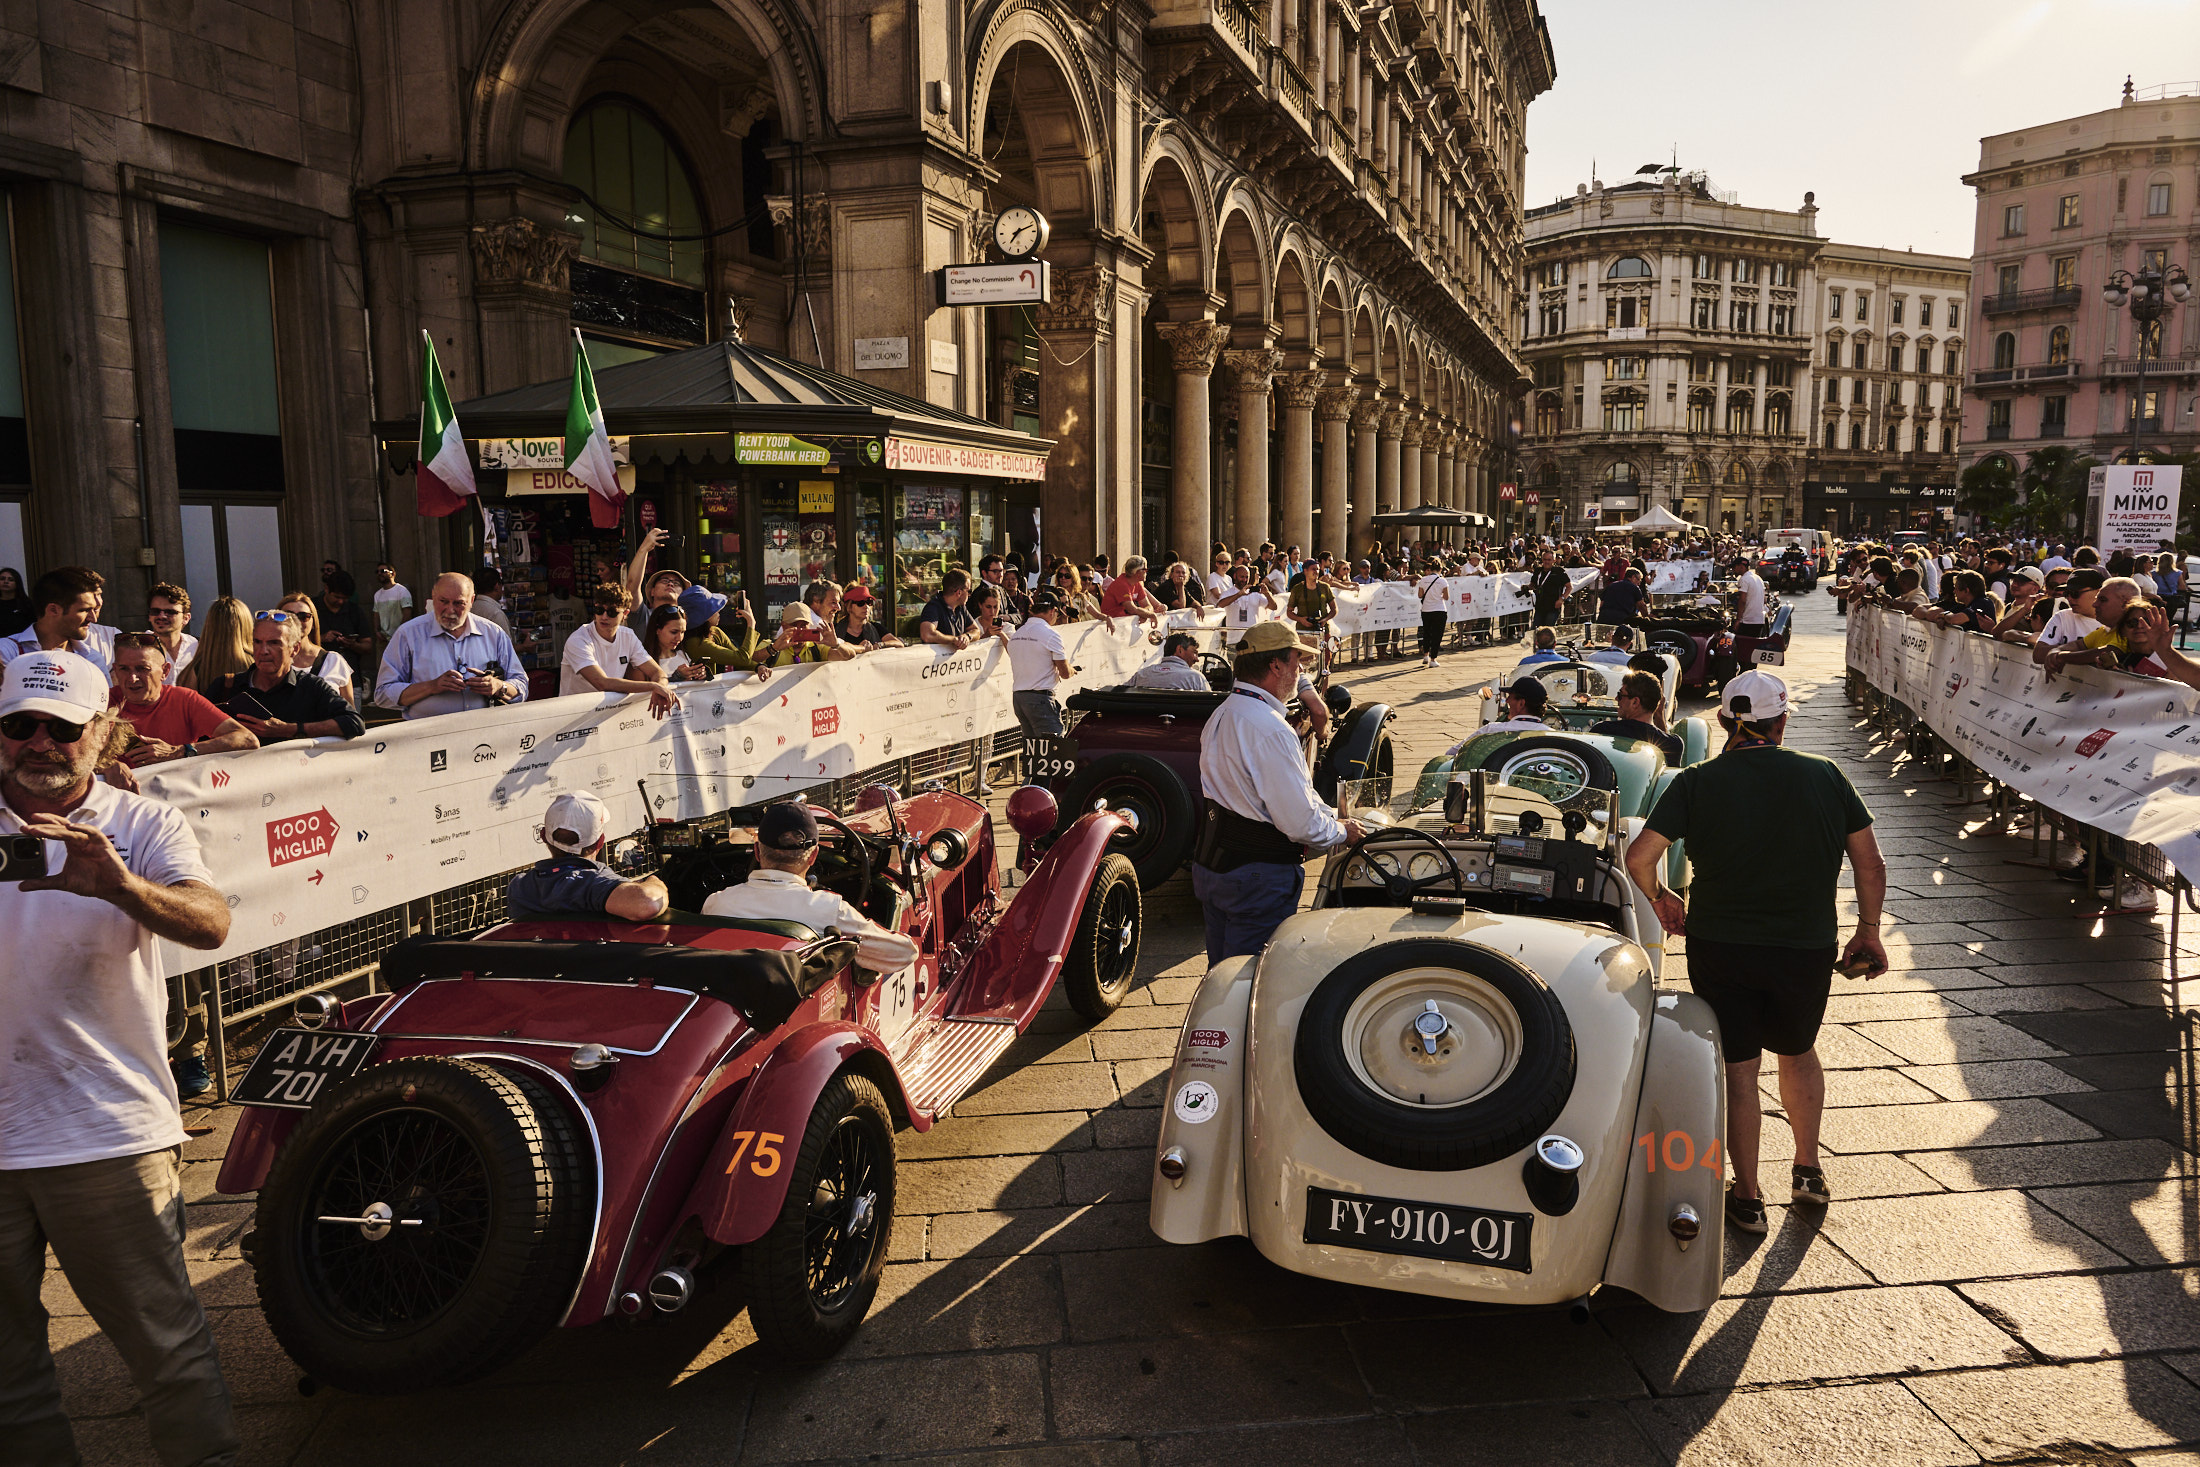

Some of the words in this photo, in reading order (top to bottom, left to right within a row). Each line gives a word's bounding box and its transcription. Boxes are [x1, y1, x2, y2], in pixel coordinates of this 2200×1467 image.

[522, 439, 559, 458] love
[739, 436, 764, 447] RENT
[766, 436, 790, 448] YOUR
[739, 450, 796, 462] POWERBANK
[798, 451, 825, 462] HERE!
[902, 445, 952, 466] SOUVENIR
[960, 450, 994, 469] GADGET
[1002, 457, 1034, 473] EDICOLA
[801, 493, 834, 503] MILANO
[1501, 487, 1514, 497] M
[1527, 494, 1538, 502] M
[2114, 495, 2168, 510] MIMO
[1902, 634, 1927, 652] CHOPARD
[1760, 652, 1774, 662] 85
[922, 658, 982, 679] CHOPARD
[22, 677, 70, 687] OFFICIAL
[24, 684, 64, 692] DRIVER
[814, 708, 834, 721] 1000
[814, 722, 835, 735] MIGLIA
[1026, 739, 1049, 756] NU
[502, 764, 530, 775] Institutional
[532, 761, 549, 769] Partner
[1028, 758, 1075, 776] 1299
[274, 816, 319, 840] 1000
[431, 834, 451, 844] Mobility
[452, 830, 471, 839] Partner
[274, 836, 326, 863] MIGLIA
[440, 856, 458, 867] waze
[892, 972, 906, 1016] 75
[273, 1035, 357, 1067] AYH
[264, 1069, 328, 1102] 701
[725, 1131, 785, 1177] 75
[1638, 1130, 1723, 1180] 104
[1328, 1198, 1515, 1261] FY-910-QJ
